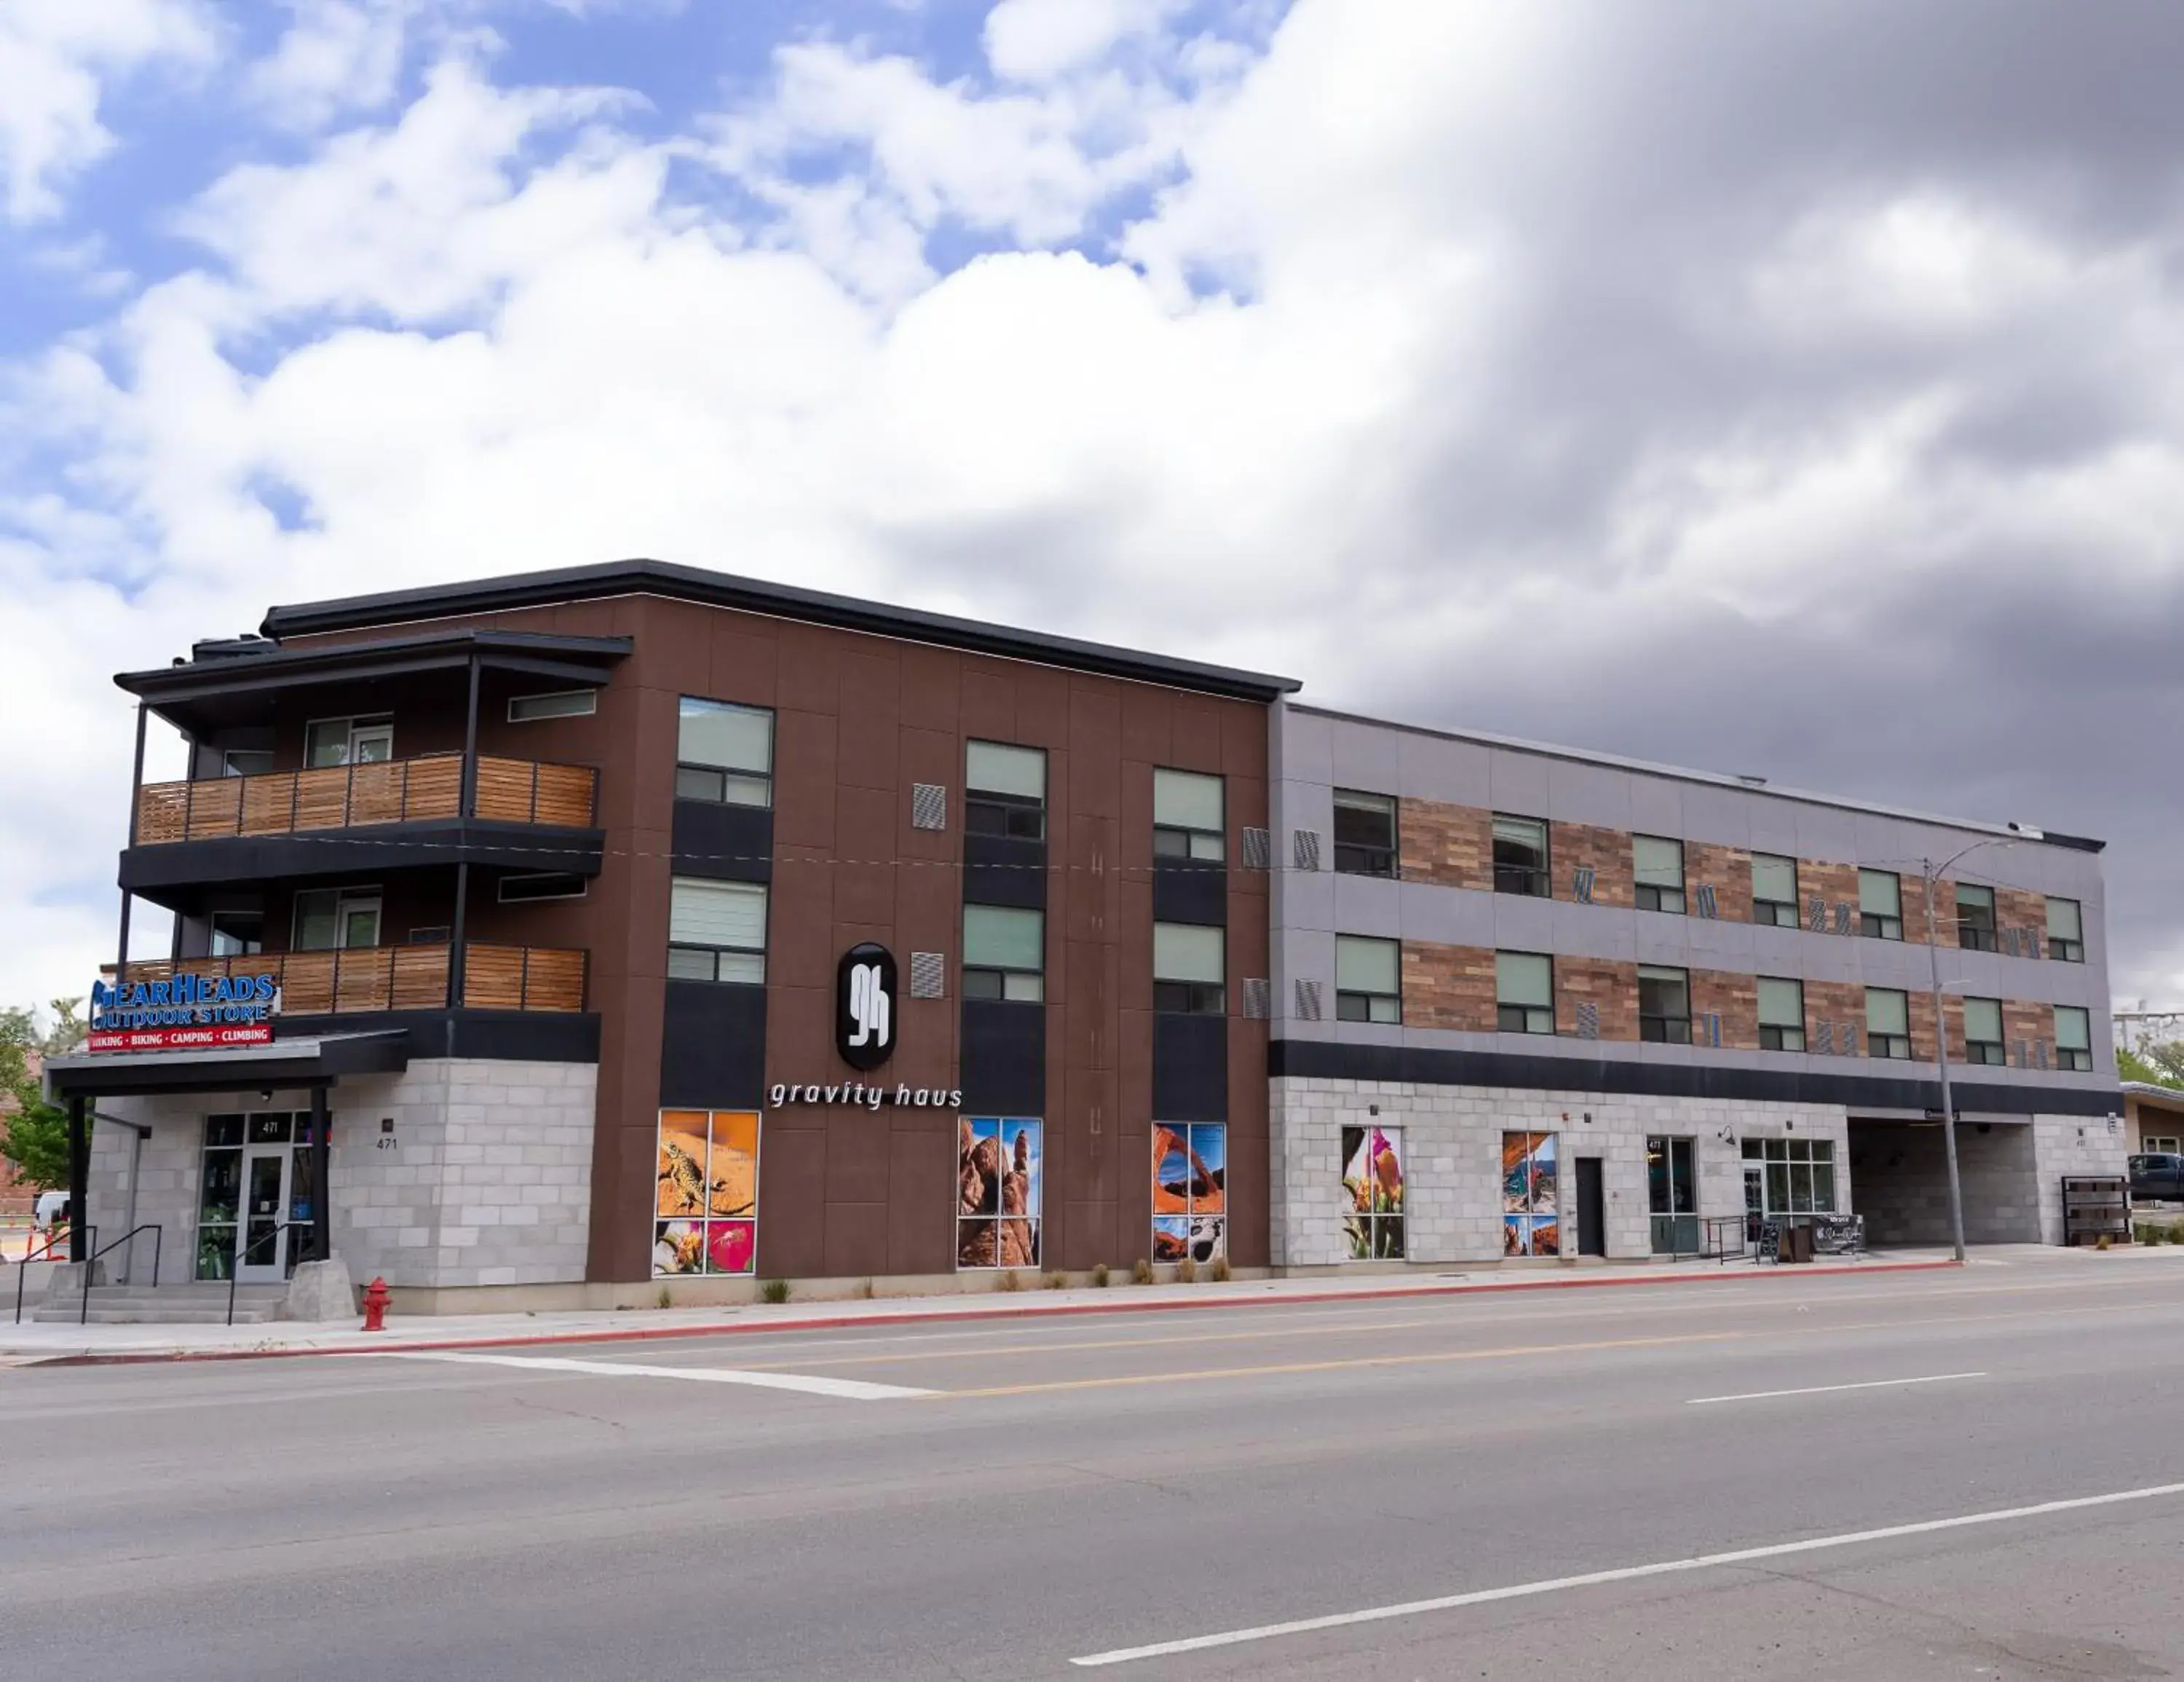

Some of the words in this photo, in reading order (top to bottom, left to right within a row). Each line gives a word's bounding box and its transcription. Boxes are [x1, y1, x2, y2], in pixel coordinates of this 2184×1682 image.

[92, 1006, 193, 1030] OUTDOOR
[199, 1002, 269, 1024] STORE
[130, 1033, 163, 1046] BIKING
[170, 1030, 213, 1044] CAMPING
[221, 1028, 268, 1041] CLIMBING
[770, 1081, 884, 1111] gravity
[894, 1083, 962, 1107] haus
[262, 1121, 279, 1134] 471
[376, 1137, 397, 1150] 471
